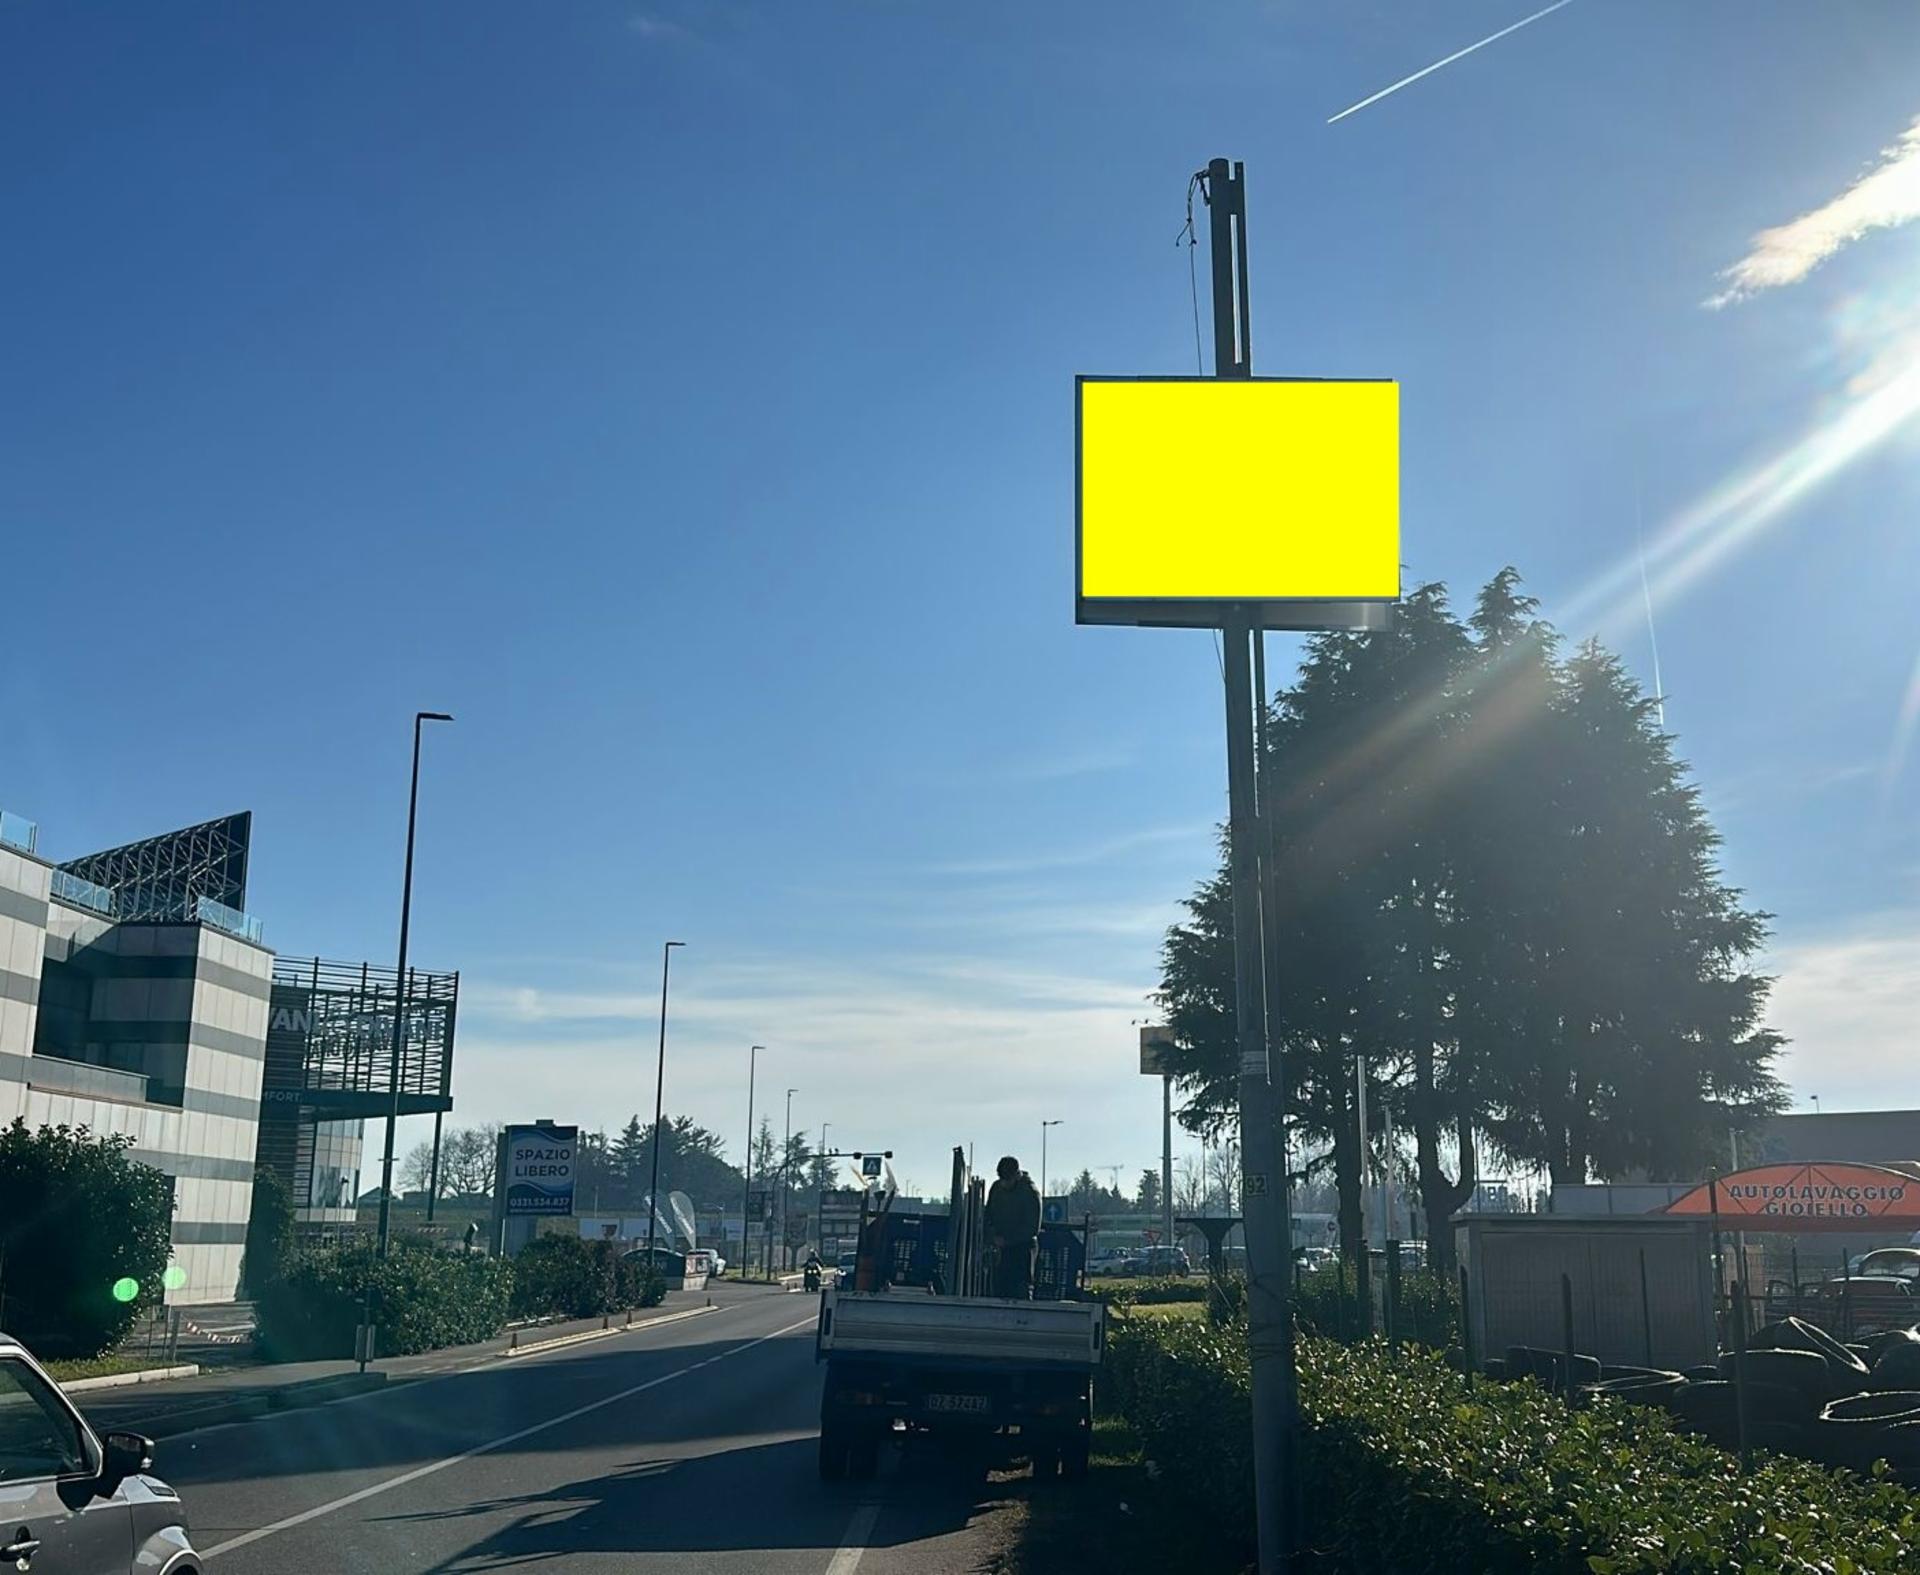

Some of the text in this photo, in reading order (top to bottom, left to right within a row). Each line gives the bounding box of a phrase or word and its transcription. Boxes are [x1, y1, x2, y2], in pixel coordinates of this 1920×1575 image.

[515, 1148, 570, 1161] SPAZIO
[515, 1165, 570, 1177] LIBERO
[1246, 1176, 1265, 1194] 92
[1729, 1185, 1904, 1200] AUTOLAVAGGIO
[1765, 1202, 1868, 1217] GIOIELLO
